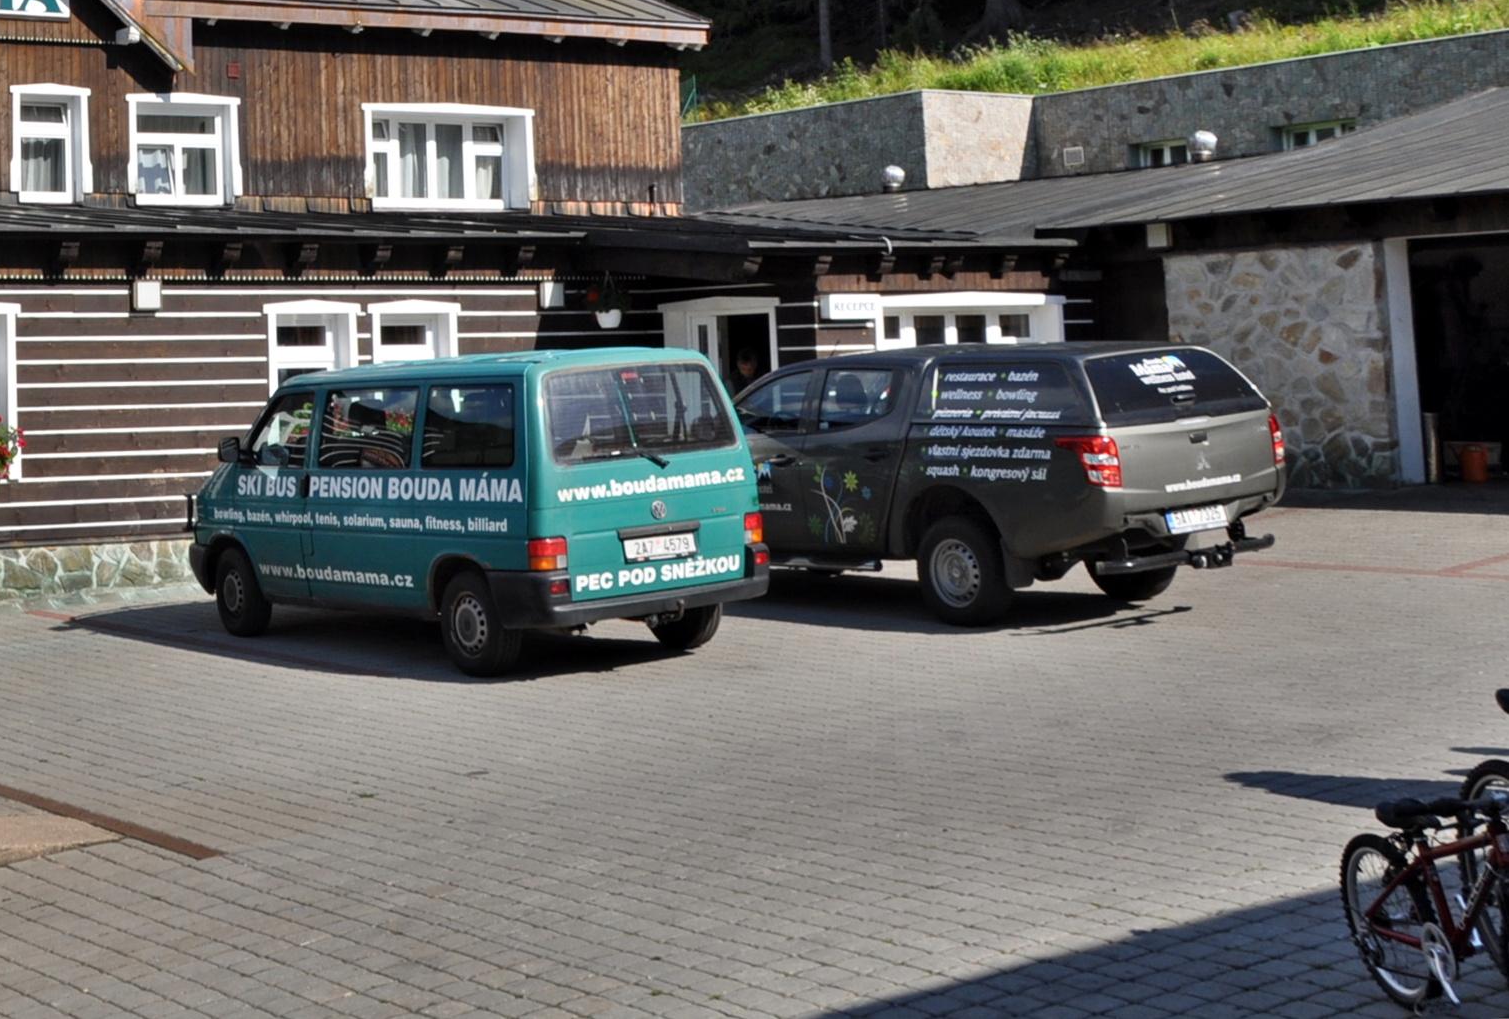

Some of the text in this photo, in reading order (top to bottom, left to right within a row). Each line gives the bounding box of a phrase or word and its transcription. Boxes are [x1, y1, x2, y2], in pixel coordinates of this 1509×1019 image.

[834, 301, 876, 311] RECEPCE
[944, 370, 1039, 382] restaurace bazén
[941, 388, 1038, 403] wellness bowling
[929, 425, 1046, 439] dětský koutek masáže
[928, 444, 1051, 460] vlastní sjezdovka zdarma
[925, 464, 1047, 482] squash kongresový sál
[237, 471, 523, 503] SKI BUS PENSION BOUDA MÁMA
[557, 467, 745, 502] www.boudamama.cz
[214, 507, 508, 533] bowling, bazén, whirpool, tenis, solarium, sauna, fitness, billiard
[635, 536, 690, 555] 2A7 4579
[258, 564, 415, 588] www.boudamama.cz
[576, 554, 741, 592] PEC POD SNĚŽKOU
